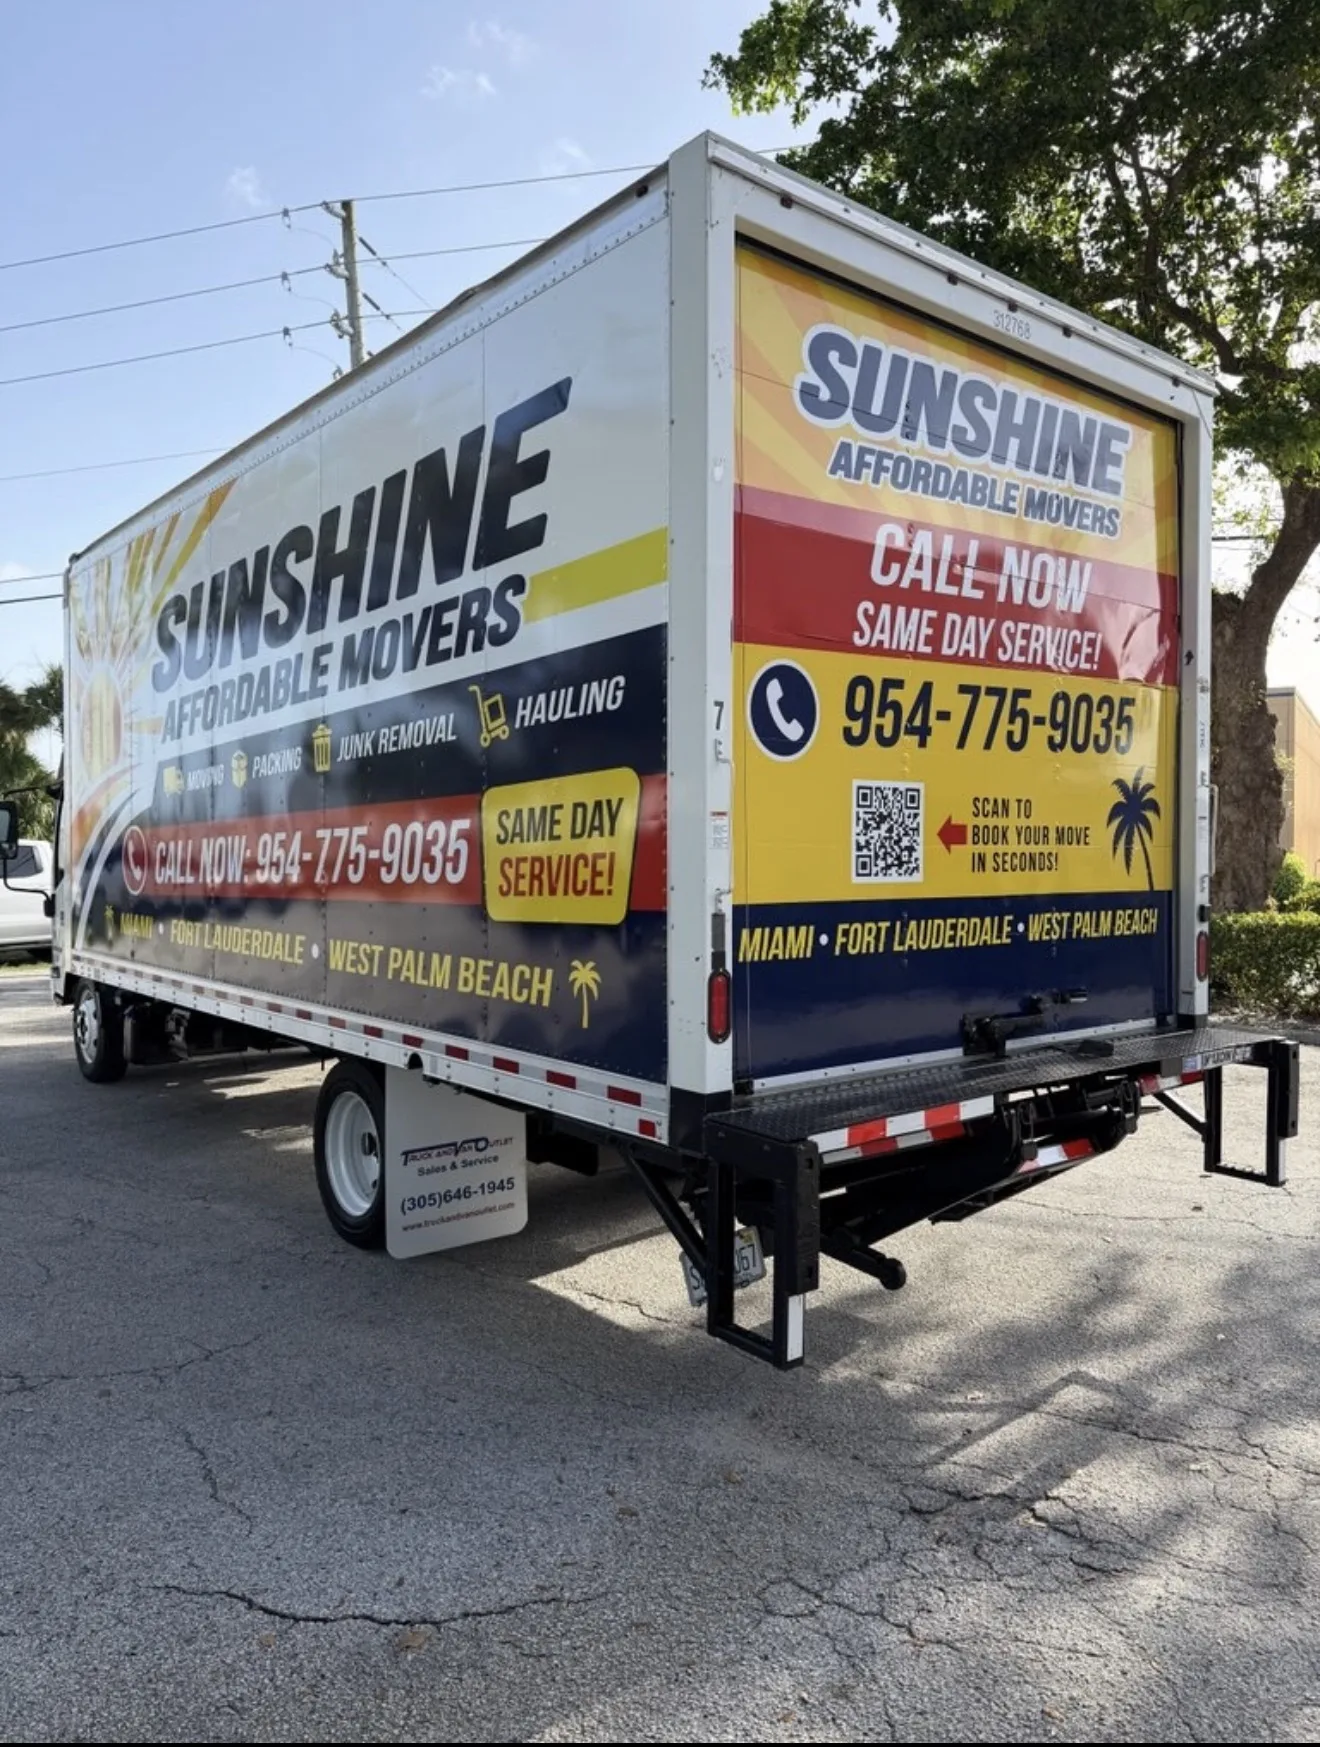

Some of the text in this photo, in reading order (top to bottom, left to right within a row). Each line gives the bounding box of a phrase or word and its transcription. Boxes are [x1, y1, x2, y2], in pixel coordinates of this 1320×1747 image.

[993, 310, 1031, 340] 312768
[798, 330, 1131, 497] SUNSHINE
[828, 441, 1120, 538] AFFORDABLE MOVERS
[152, 376, 572, 692] SUNSHINE
[870, 523, 1092, 614] CALL NOW
[161, 574, 526, 744] AFFORDABLE MOVERS
[853, 600, 1103, 671] SAME DAY SERVICE!
[515, 675, 625, 729] HAULING
[713, 701, 725, 731] 7
[842, 674, 1136, 755] 954-775-9035
[337, 713, 457, 763] JUNK REMOVAL
[187, 764, 224, 791] MOVING
[252, 747, 302, 779] PACKING
[496, 797, 624, 845] SAME DAY
[972, 797, 1032, 819] SCAN TO
[155, 819, 471, 885] CALL NOW: 954-775-9035
[972, 825, 1090, 845] BOOK YOUR MOVE
[498, 851, 615, 897] SERVICE!
[972, 852, 1058, 872] IN SECONDS!
[738, 908, 1158, 962] MIAMI FORT LAUDERDALE WEST PALM BEACH
[120, 913, 553, 1008] MIAMI FORT LAUDERDALE WEST PALM BEACH
[418, 1154, 499, 1176] Sales & Service
[400, 1177, 515, 1215] (305)646-1945
[402, 1202, 515, 1232] www.truckandvanoutlet.com
